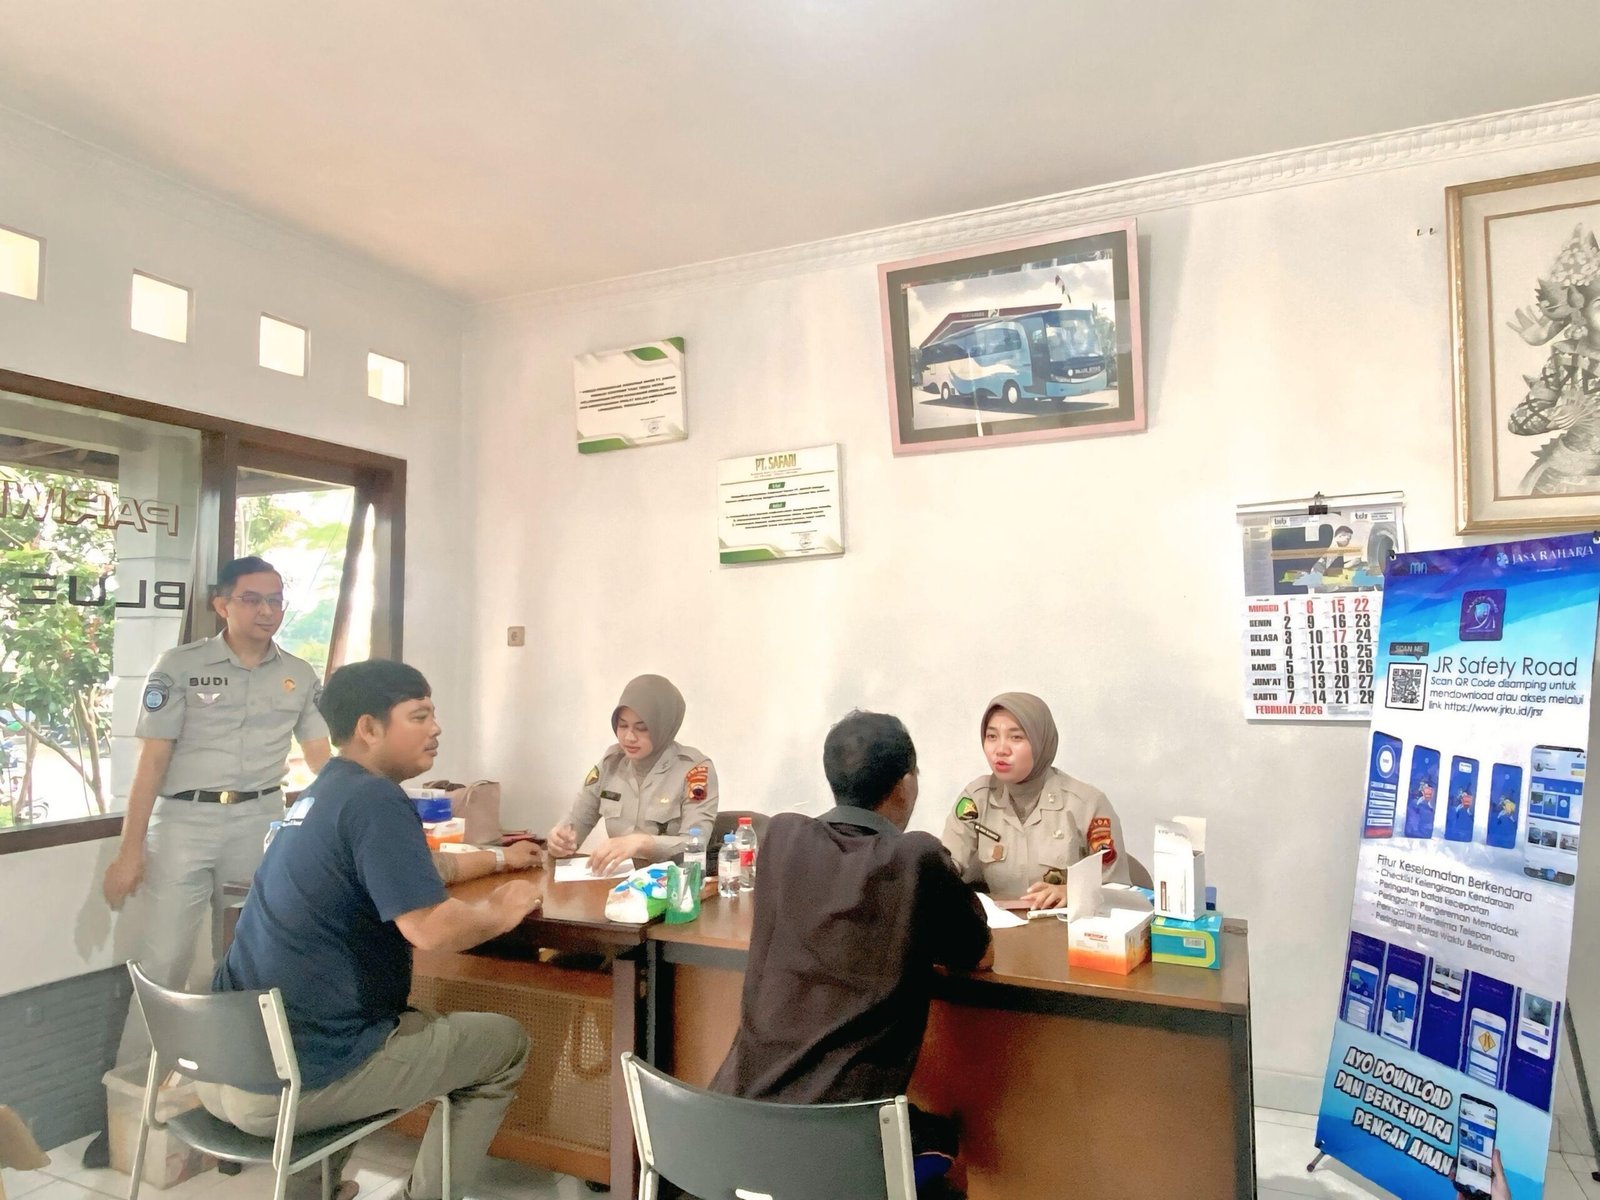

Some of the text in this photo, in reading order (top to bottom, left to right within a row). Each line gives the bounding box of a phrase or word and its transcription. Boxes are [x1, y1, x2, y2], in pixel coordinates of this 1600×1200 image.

[755, 453, 797, 472] PT. SAFARI
[1249, 598, 1369, 615] MINGGU 1 8 15 22
[1249, 613, 1371, 630] SENIN 2 9 16 23
[1250, 629, 1372, 645] SELASA 3 10 17 24
[1250, 644, 1373, 660] RABU 4 11 18 25
[1395, 645, 1424, 653] SCAN ME
[1251, 659, 1373, 675] KAMIS 5 12 19 26
[1433, 656, 1578, 678] JR Safety Road
[189, 677, 229, 687] BUDI
[1252, 674, 1374, 689] JUM'AT 6 13 20 27
[1431, 677, 1577, 691] Scan QR Code disamping untuk
[1253, 690, 1374, 704] SABTU 7 14 21 28
[1430, 689, 1584, 705] mendownload atau akses melalui
[1256, 705, 1297, 715] FEBRUARI
[1299, 705, 1323, 715] 2026
[1429, 701, 1442, 711] link
[1377, 854, 1533, 902] Fitur Keselamatan Berkendara
[1379, 879, 1489, 916] Peringatan batas kecepatan
[1381, 868, 1515, 910] Checklist Kelengkapan Kendaraan
[1376, 900, 1417, 919] Peringatan
[1419, 912, 1457, 932] Menerima
[1378, 890, 1519, 937] Peringatan Pengereman Mendadak
[1376, 911, 1415, 930] Peringatan
[1417, 924, 1439, 938] Batas
[1467, 939, 1515, 962] Berkendara
[1344, 1046, 1453, 1109] AYO DOWNLOAD
[1334, 1070, 1454, 1144] DAN BERKENDARA
[1353, 1108, 1457, 1176] DENGAN AMAN
